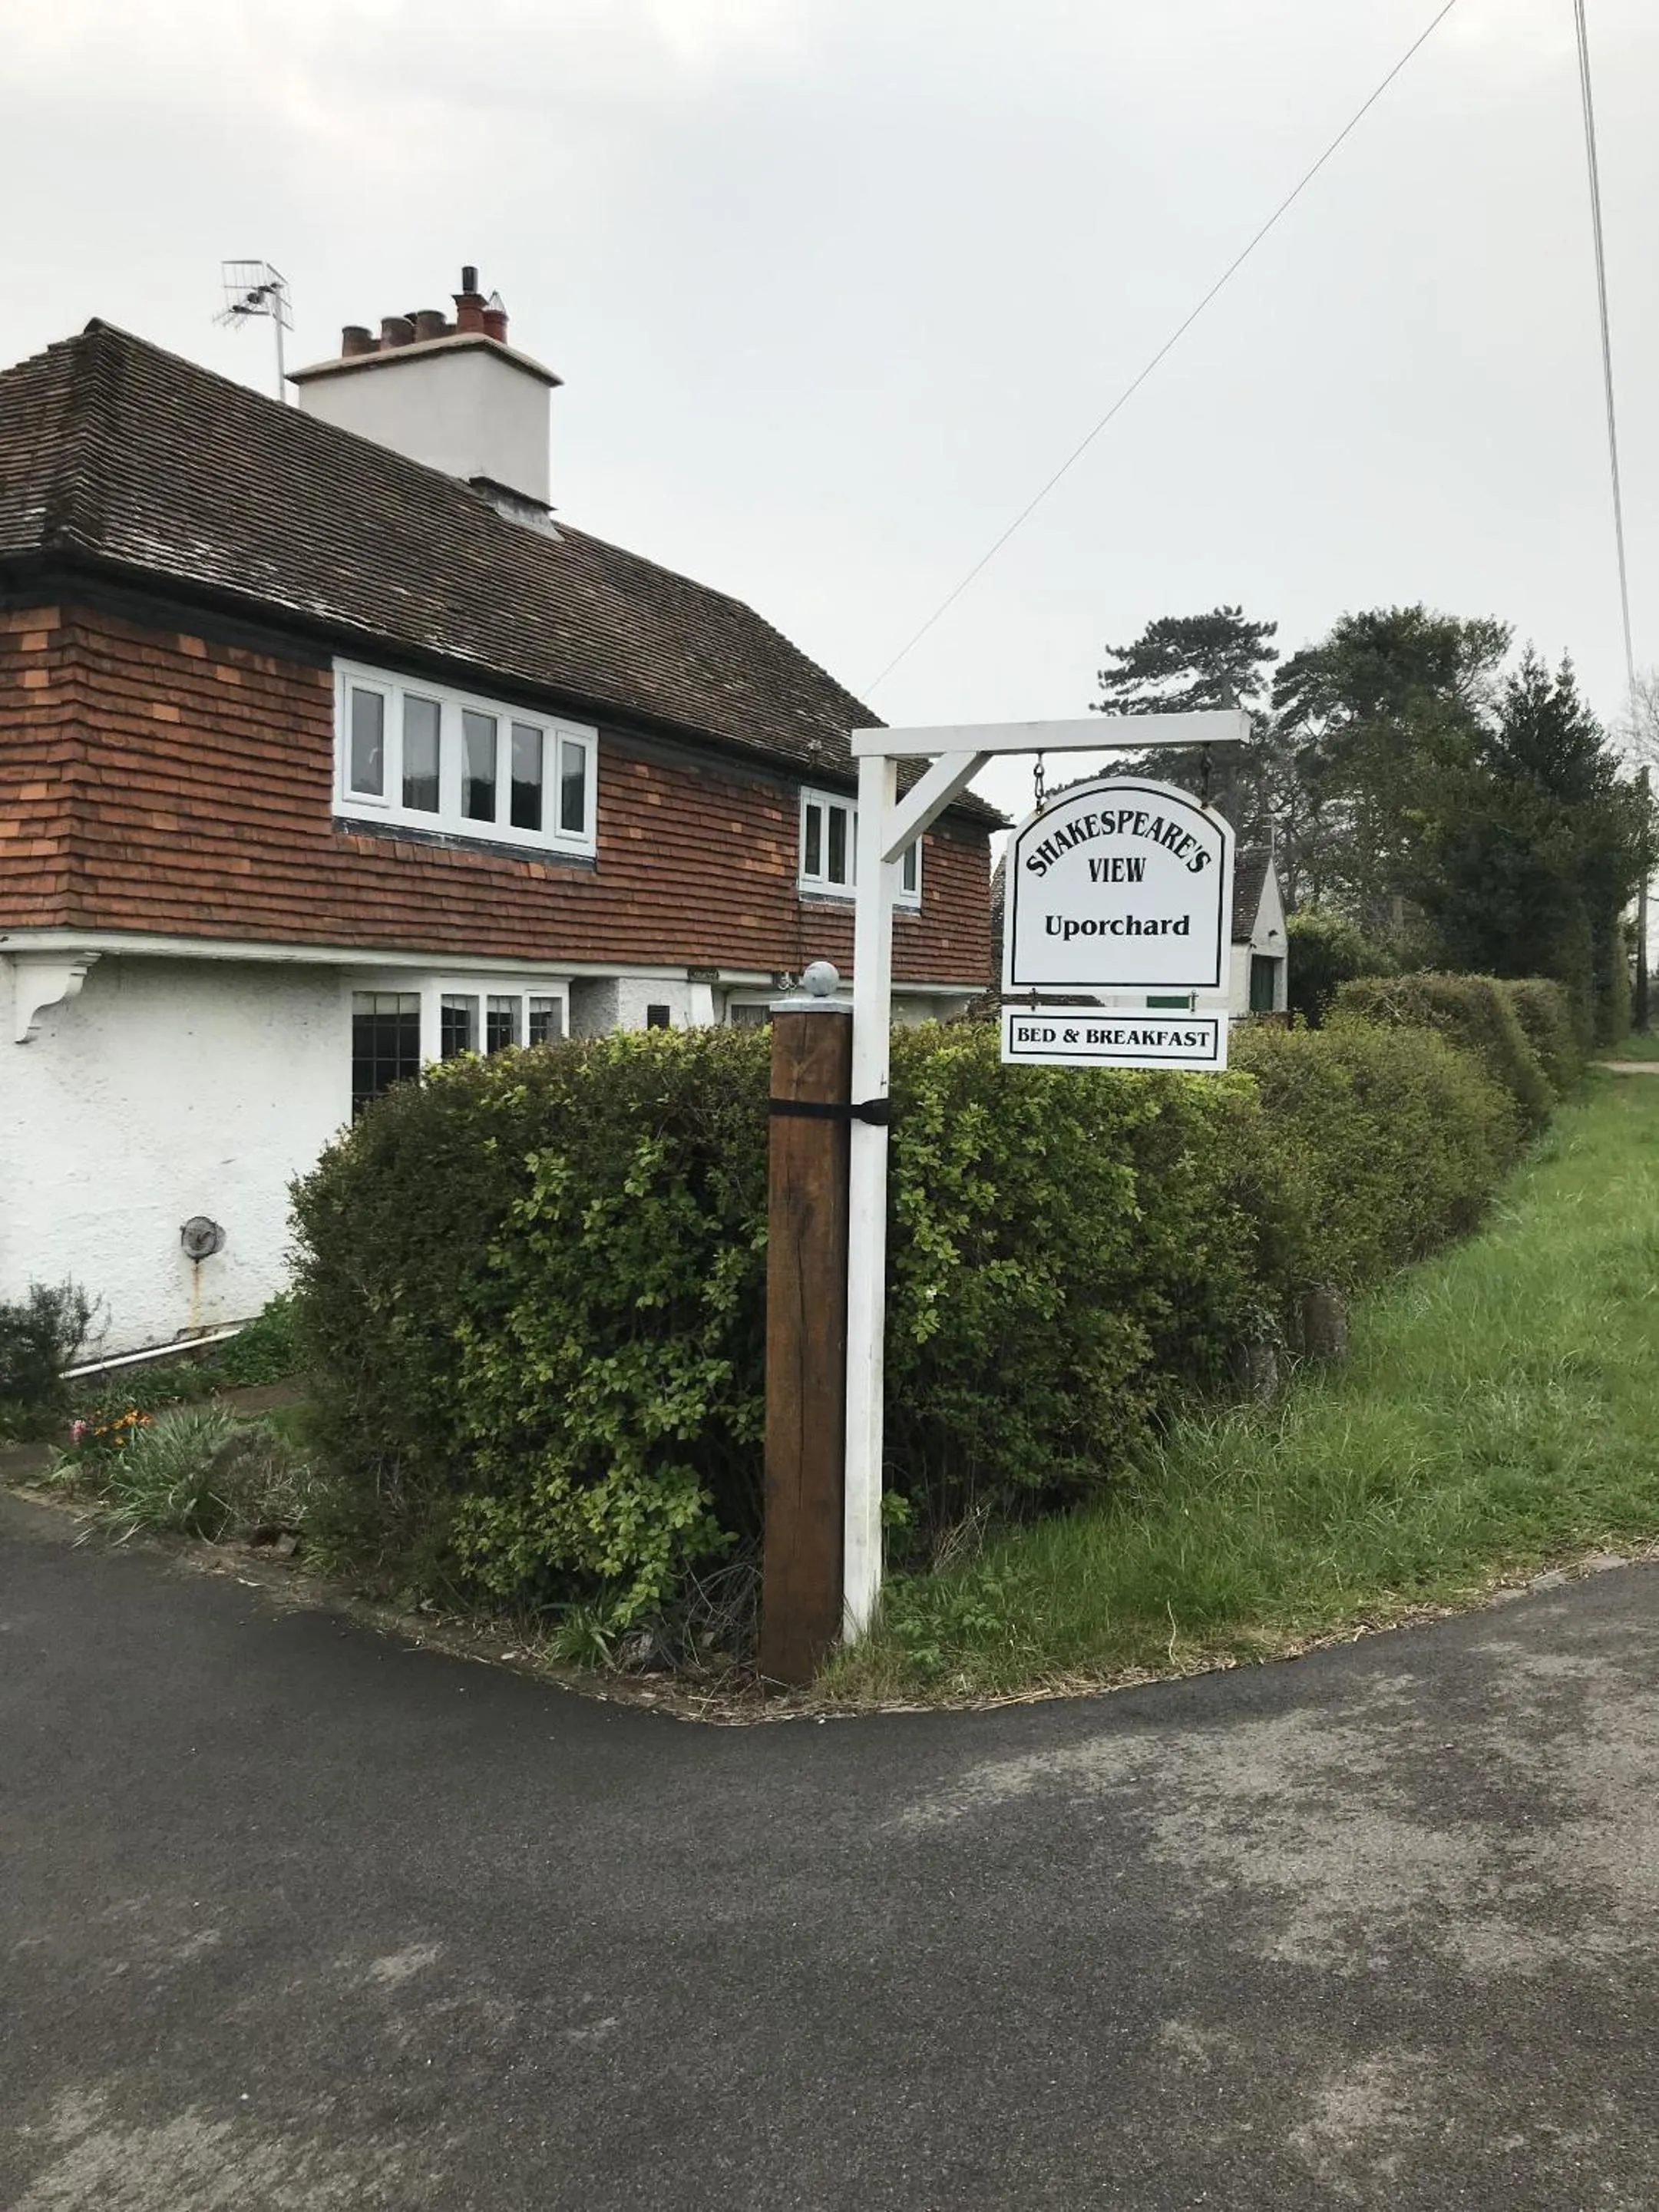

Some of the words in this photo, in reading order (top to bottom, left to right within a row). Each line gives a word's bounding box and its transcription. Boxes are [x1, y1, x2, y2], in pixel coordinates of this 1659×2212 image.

[1026, 810, 1211, 878] SHAKESPEARE'S
[1088, 858, 1147, 883] VIEW
[1045, 914, 1190, 941] Uporchard
[1018, 1027, 1056, 1043] BED
[1062, 1029, 1080, 1043] &
[1086, 1029, 1210, 1046] BREAKFAST
